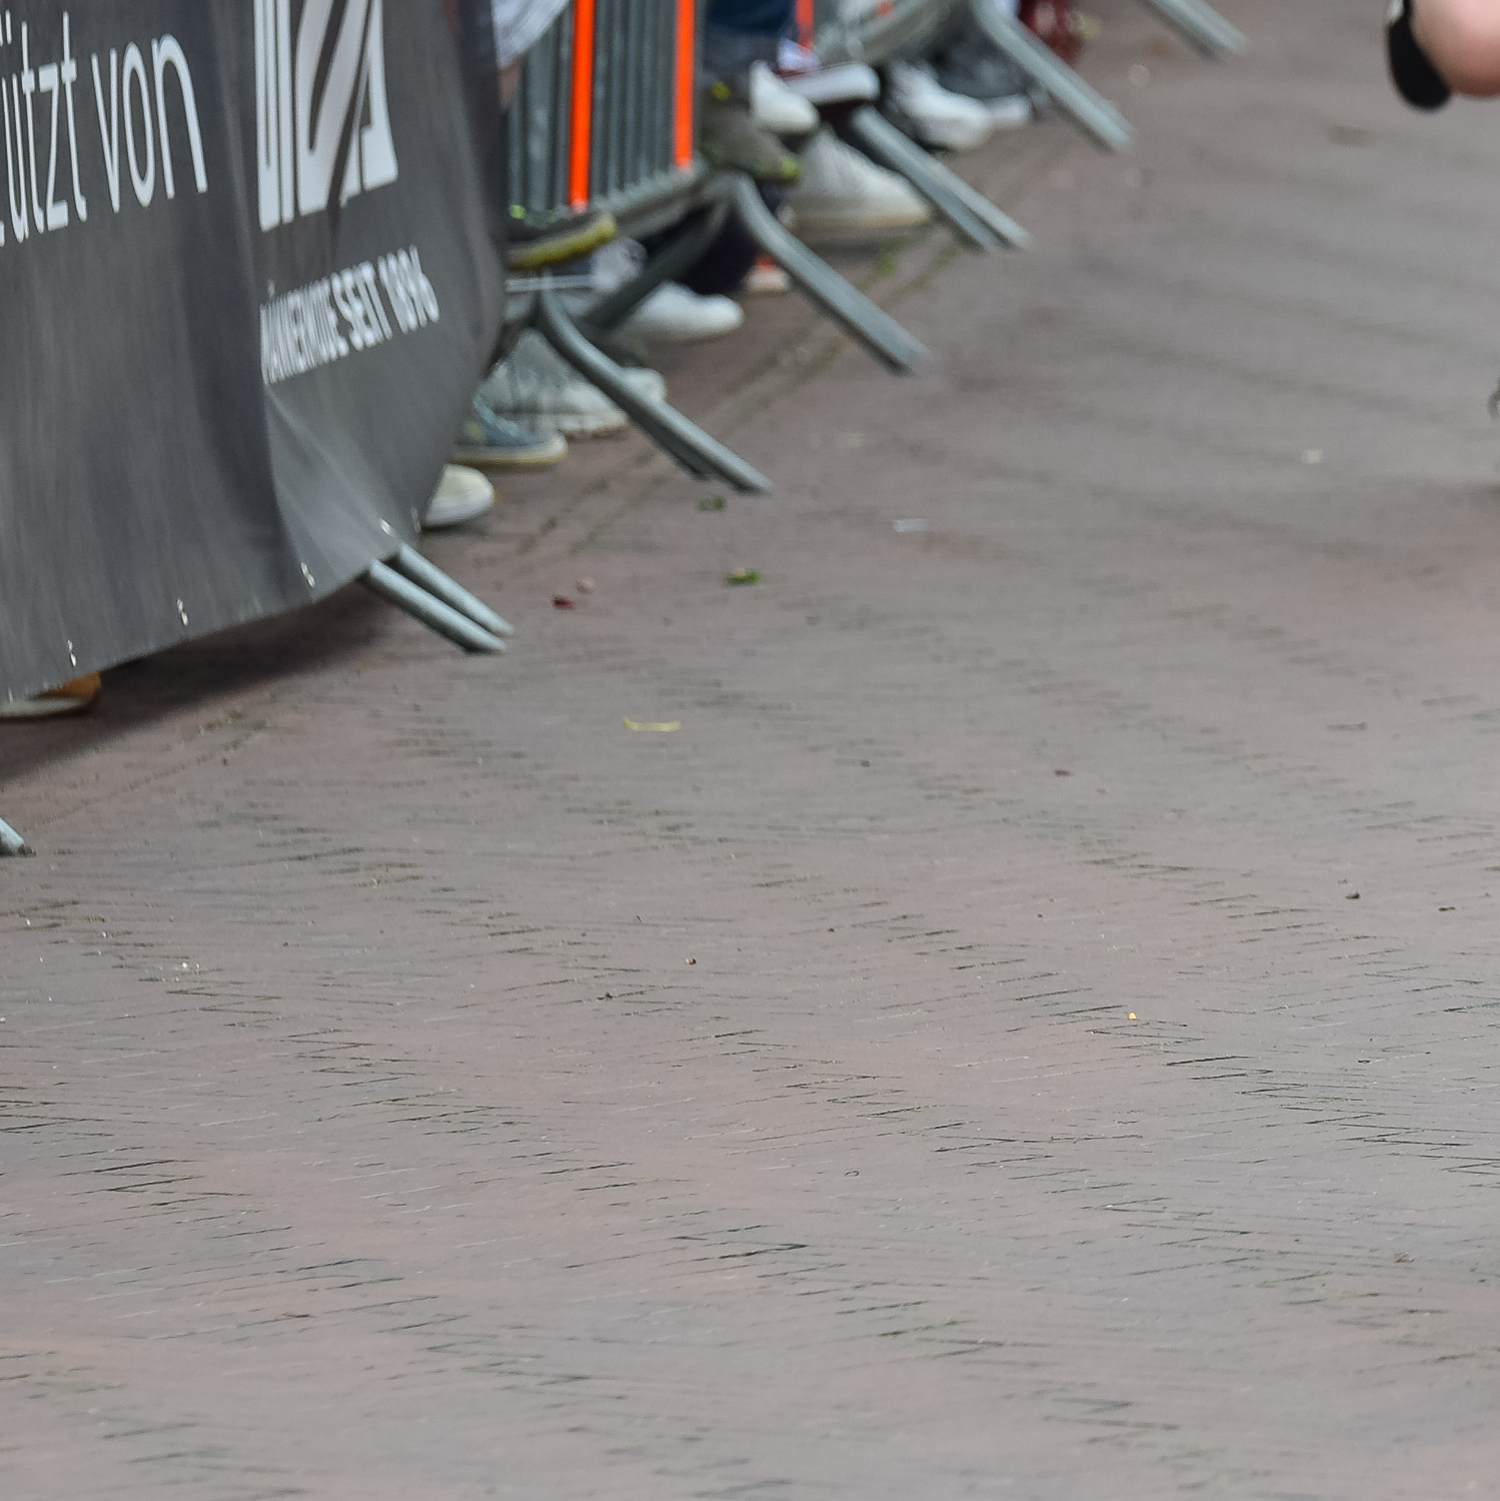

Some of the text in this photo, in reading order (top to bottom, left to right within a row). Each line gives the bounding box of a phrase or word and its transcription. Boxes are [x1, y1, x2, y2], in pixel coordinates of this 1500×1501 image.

[0, 9, 209, 248] ützt von
[331, 259, 394, 352] SEIT
